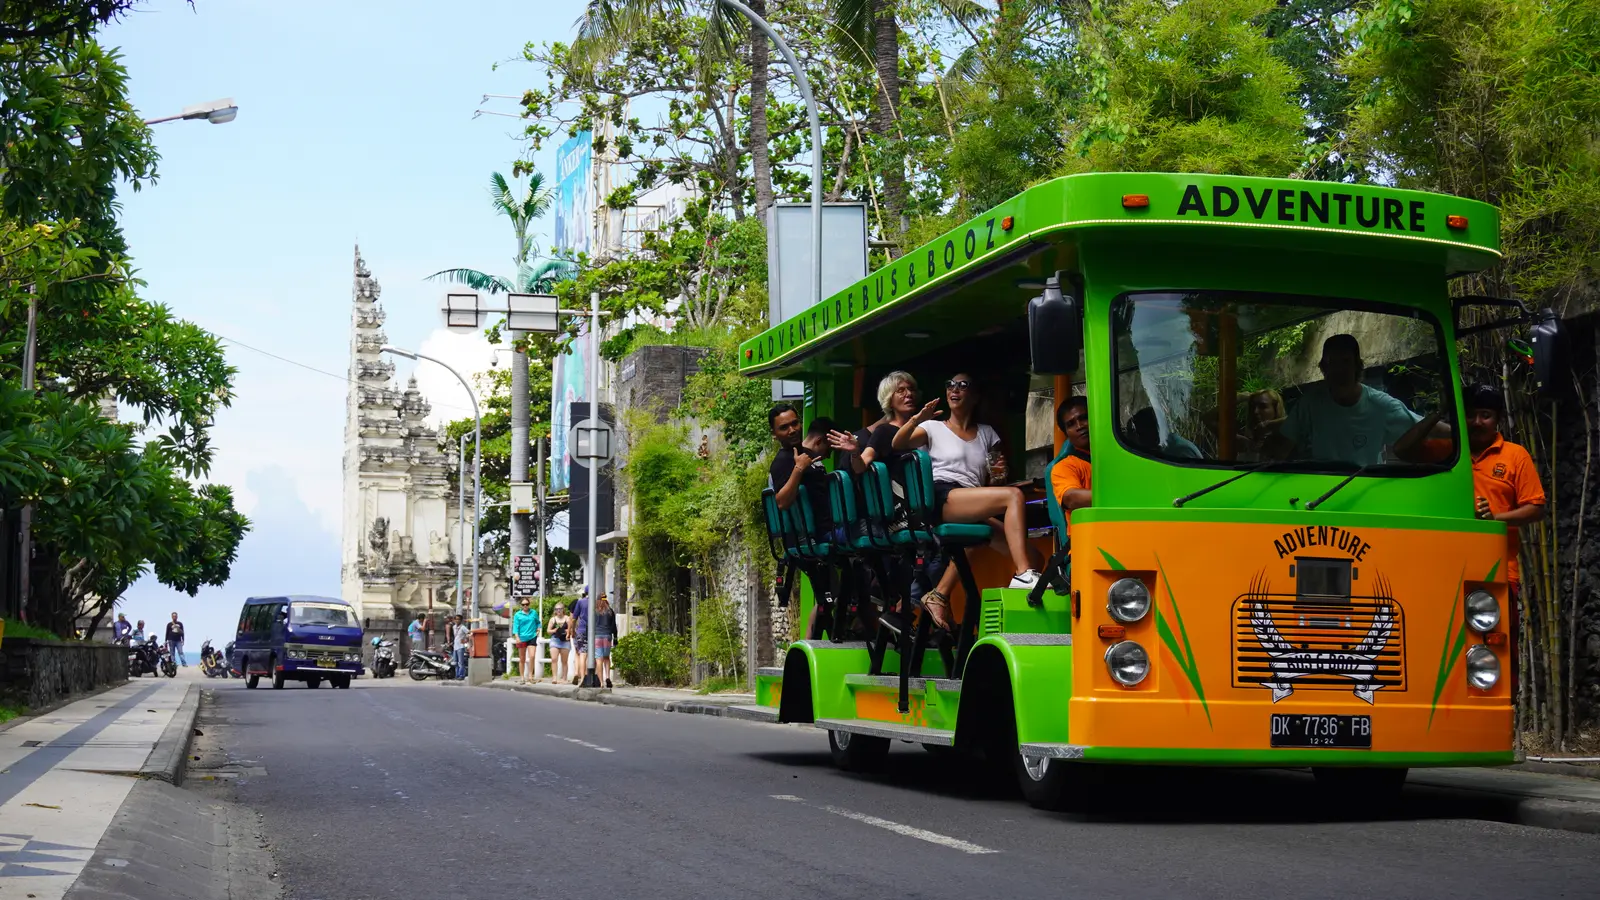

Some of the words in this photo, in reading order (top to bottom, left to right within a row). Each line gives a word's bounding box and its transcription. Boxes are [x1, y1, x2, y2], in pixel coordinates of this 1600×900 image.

[1177, 185, 1425, 232] ADVENTURE
[758, 293, 854, 363] ADVENTURE
[862, 268, 897, 311] BUS
[908, 262, 916, 288] &
[927, 217, 995, 278] BOOZ
[1273, 525, 1371, 562] ADVENTURE
[1272, 716, 1290, 735] DK
[1302, 716, 1338, 736] 7736
[1352, 717, 1370, 736] FB
